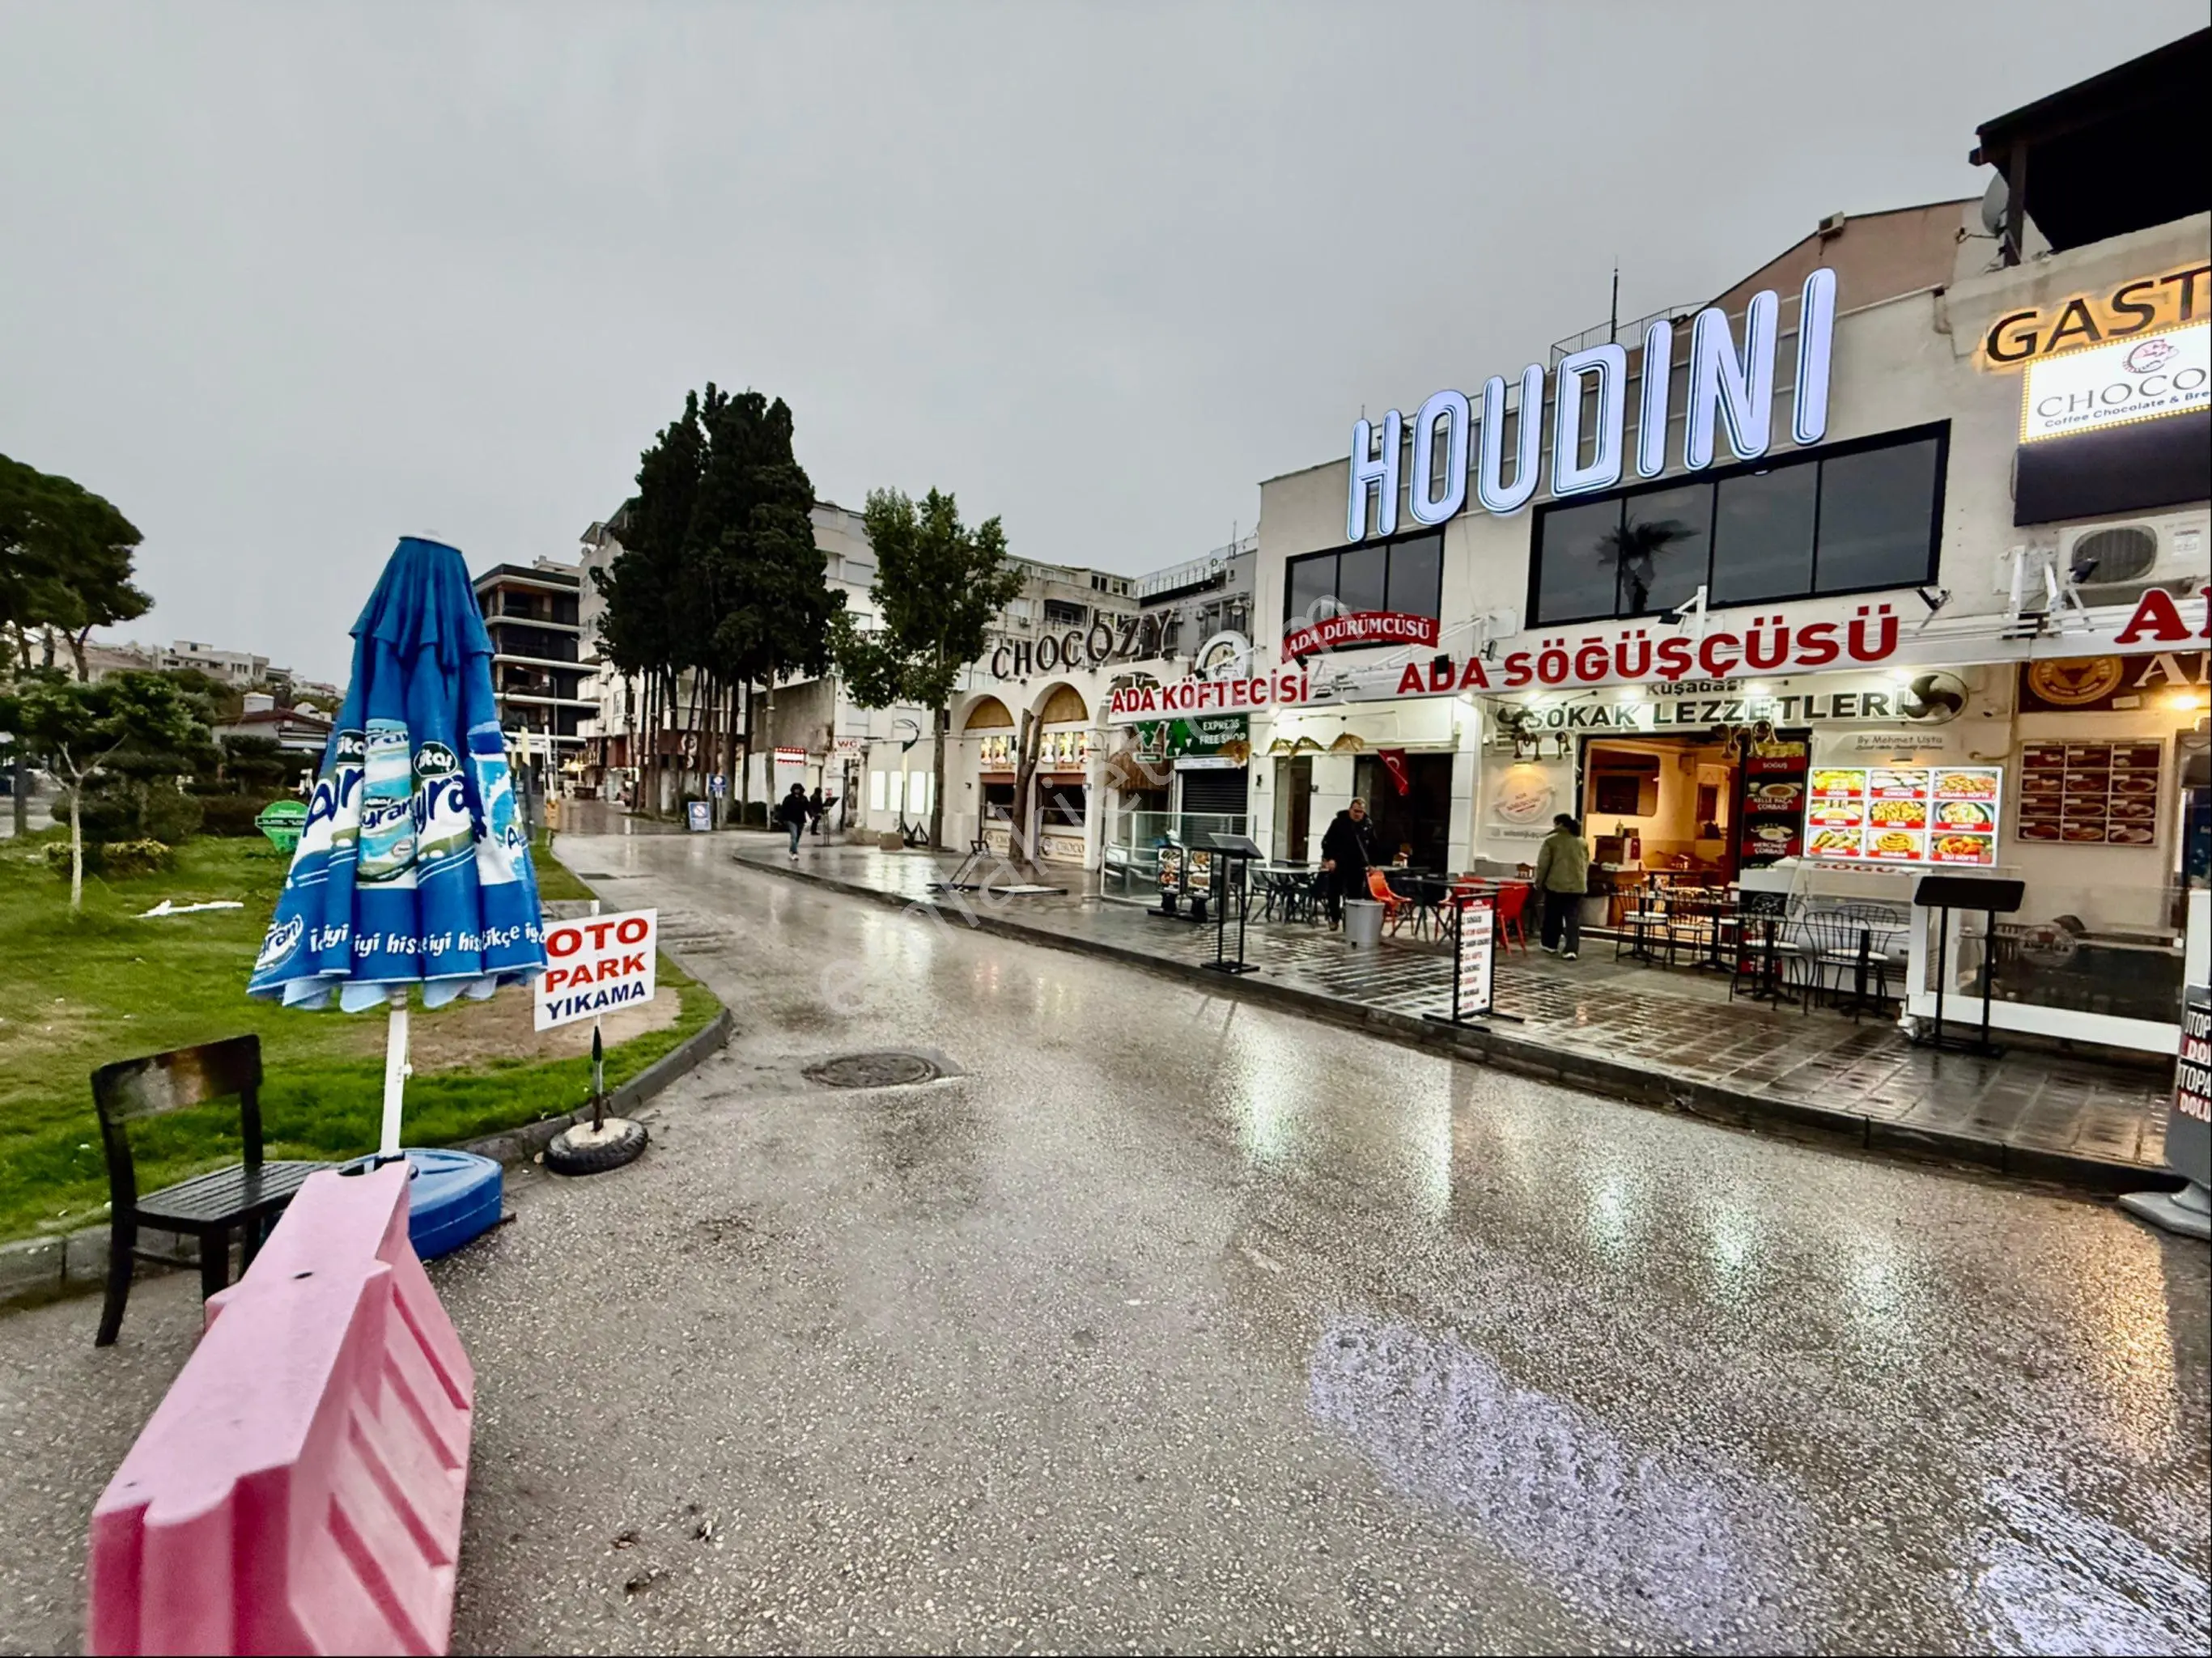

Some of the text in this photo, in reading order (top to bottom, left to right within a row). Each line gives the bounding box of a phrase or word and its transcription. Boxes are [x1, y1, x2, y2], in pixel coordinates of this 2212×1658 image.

[1346, 268, 1837, 544] HOUDINI
[2037, 368, 2206, 418] CHOCO
[2044, 412, 2089, 428] Coffee
[2093, 400, 2165, 419] Chocolate
[2169, 393, 2179, 403] &
[1288, 613, 1431, 655] ADA DÜRÜMCÜSÜ
[1397, 604, 1899, 694] ADA SÖĞÜŞÇÜSÜ
[1111, 688, 1156, 713] ADA
[1162, 666, 1308, 710] KÖFTECİSİ
[838, 738, 859, 748] WC
[1873, 735, 1913, 744] Mehmet
[546, 918, 648, 958] OTO
[546, 952, 647, 993] PARK
[546, 981, 646, 1020] YIKAMA
